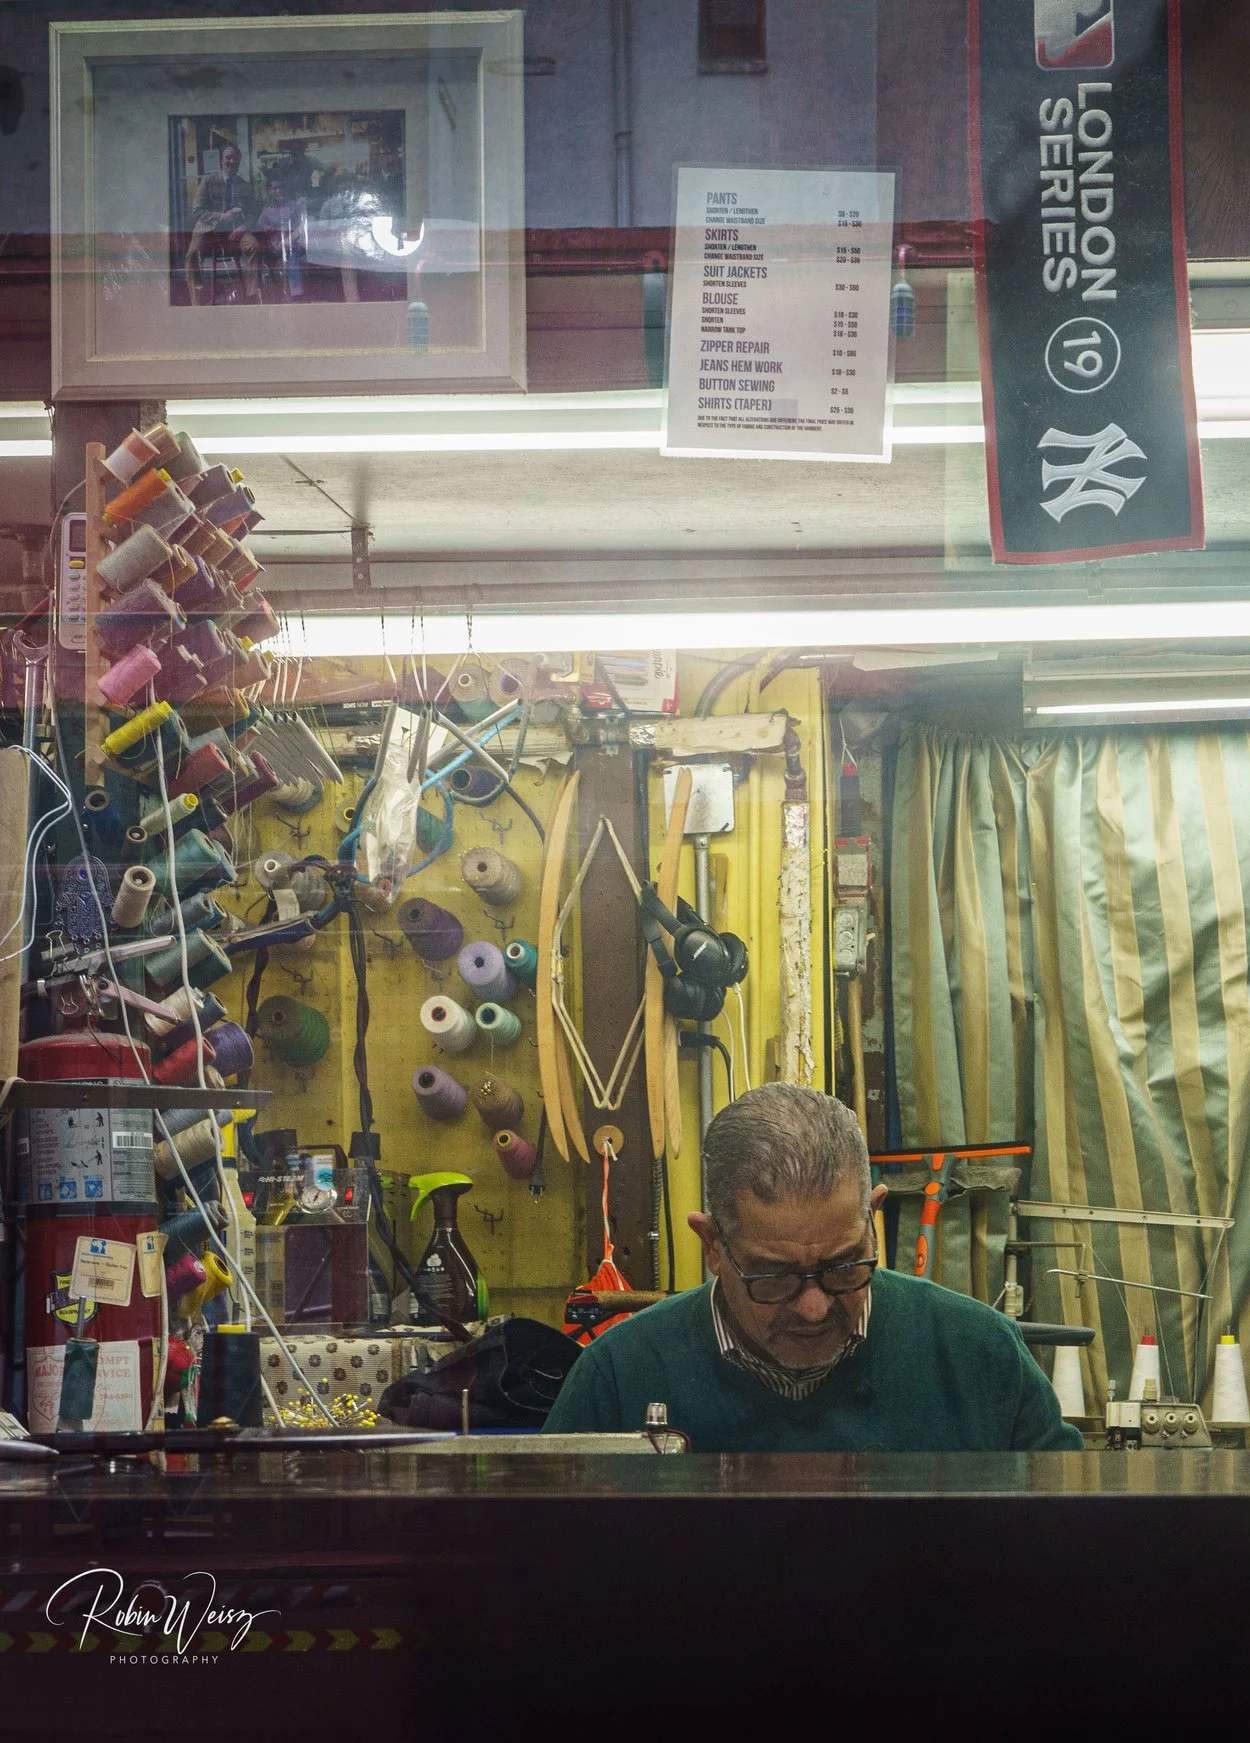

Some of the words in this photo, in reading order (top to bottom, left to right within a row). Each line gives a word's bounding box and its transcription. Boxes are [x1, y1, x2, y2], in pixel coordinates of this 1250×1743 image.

[707, 192, 738, 205] PANTS
[1039, 98, 1078, 292] SERIES
[1078, 82, 1117, 301] LONDON
[705, 228, 739, 241] SKIRTS
[703, 265, 725, 277] SUIT
[726, 266, 768, 279] JACKETS
[702, 292, 739, 305] BLOUSE
[700, 340, 734, 353] ZIPPER
[736, 341, 770, 354] REPAIR
[1063, 330, 1103, 378] 19
[699, 359, 729, 372] JEANS
[731, 360, 752, 373] HEM
[755, 361, 783, 374] WORK
[699, 378, 736, 391] BUTTON
[738, 379, 775, 392] SEWING
[698, 397, 732, 410] SHIRTS
